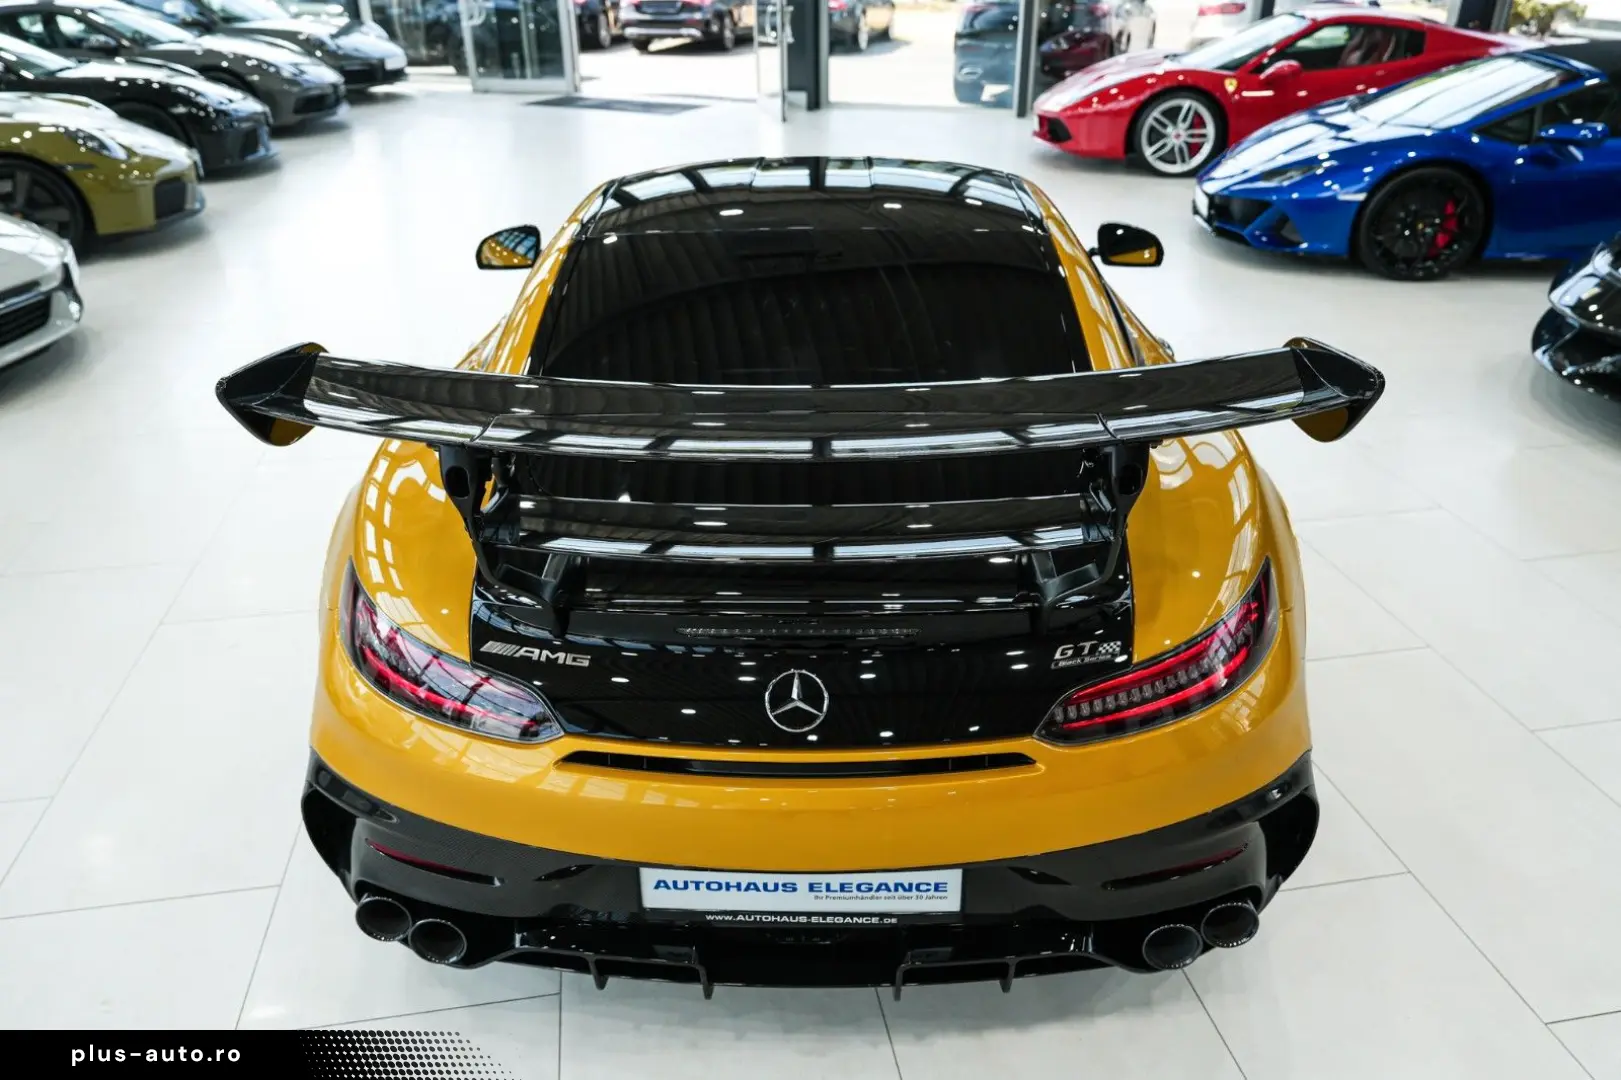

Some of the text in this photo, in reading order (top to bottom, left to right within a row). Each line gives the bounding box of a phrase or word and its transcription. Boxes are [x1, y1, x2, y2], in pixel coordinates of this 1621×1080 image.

[513, 646, 591, 667] AMG
[1053, 640, 1098, 660] GT
[653, 879, 948, 893] AUTOHAUS ELEGANCE
